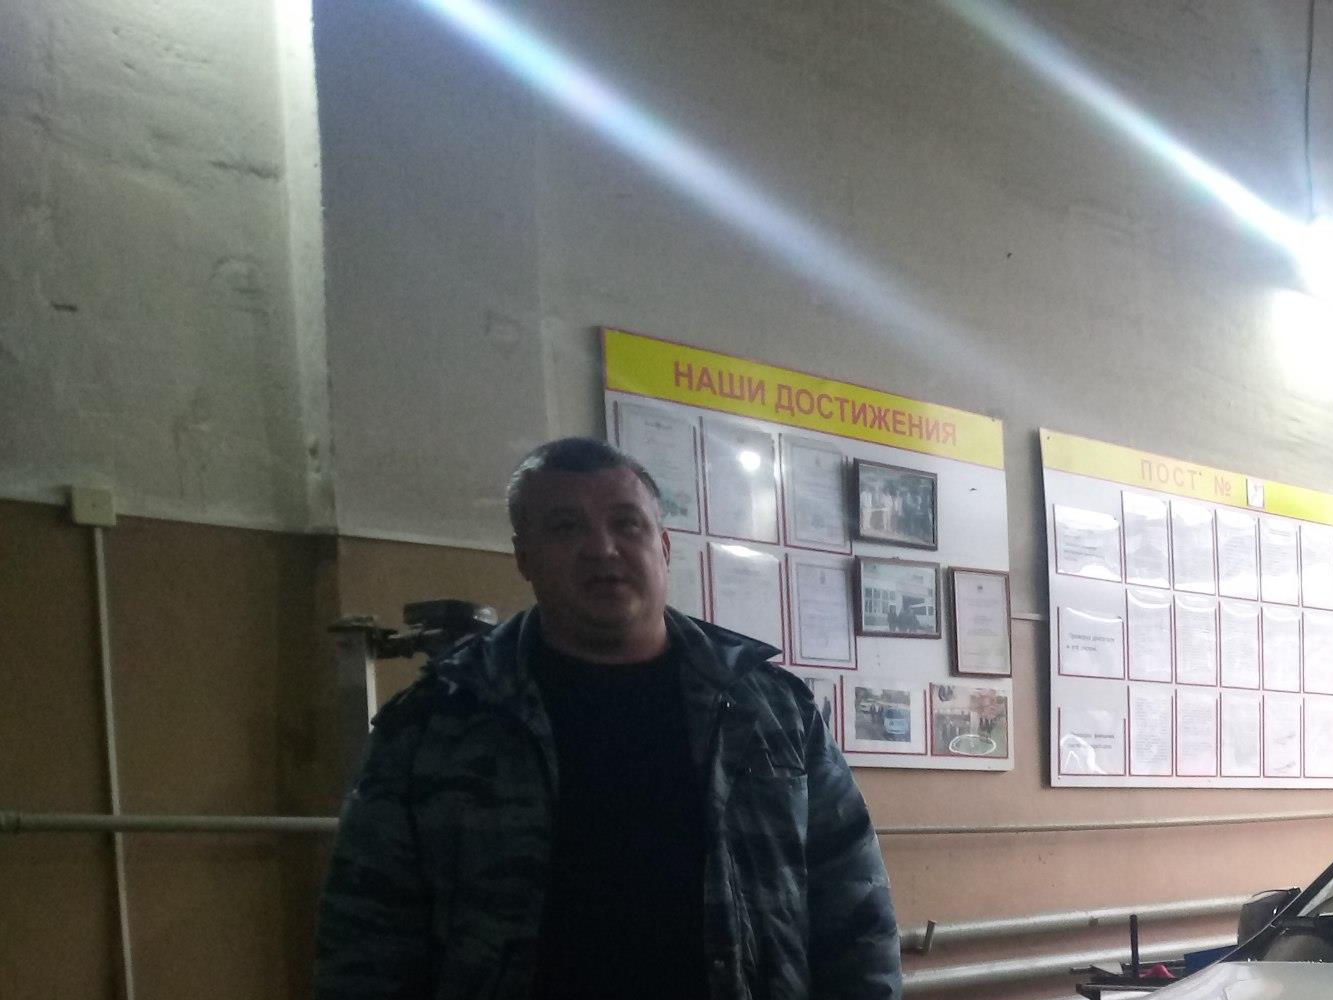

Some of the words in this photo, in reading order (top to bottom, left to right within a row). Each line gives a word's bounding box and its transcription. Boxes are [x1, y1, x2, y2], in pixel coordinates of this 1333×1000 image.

[674, 360, 767, 406] НАШИ
[774, 384, 957, 447] ДОСТИЖЕНИЯ
[1140, 458, 1199, 488] ПОСТ
